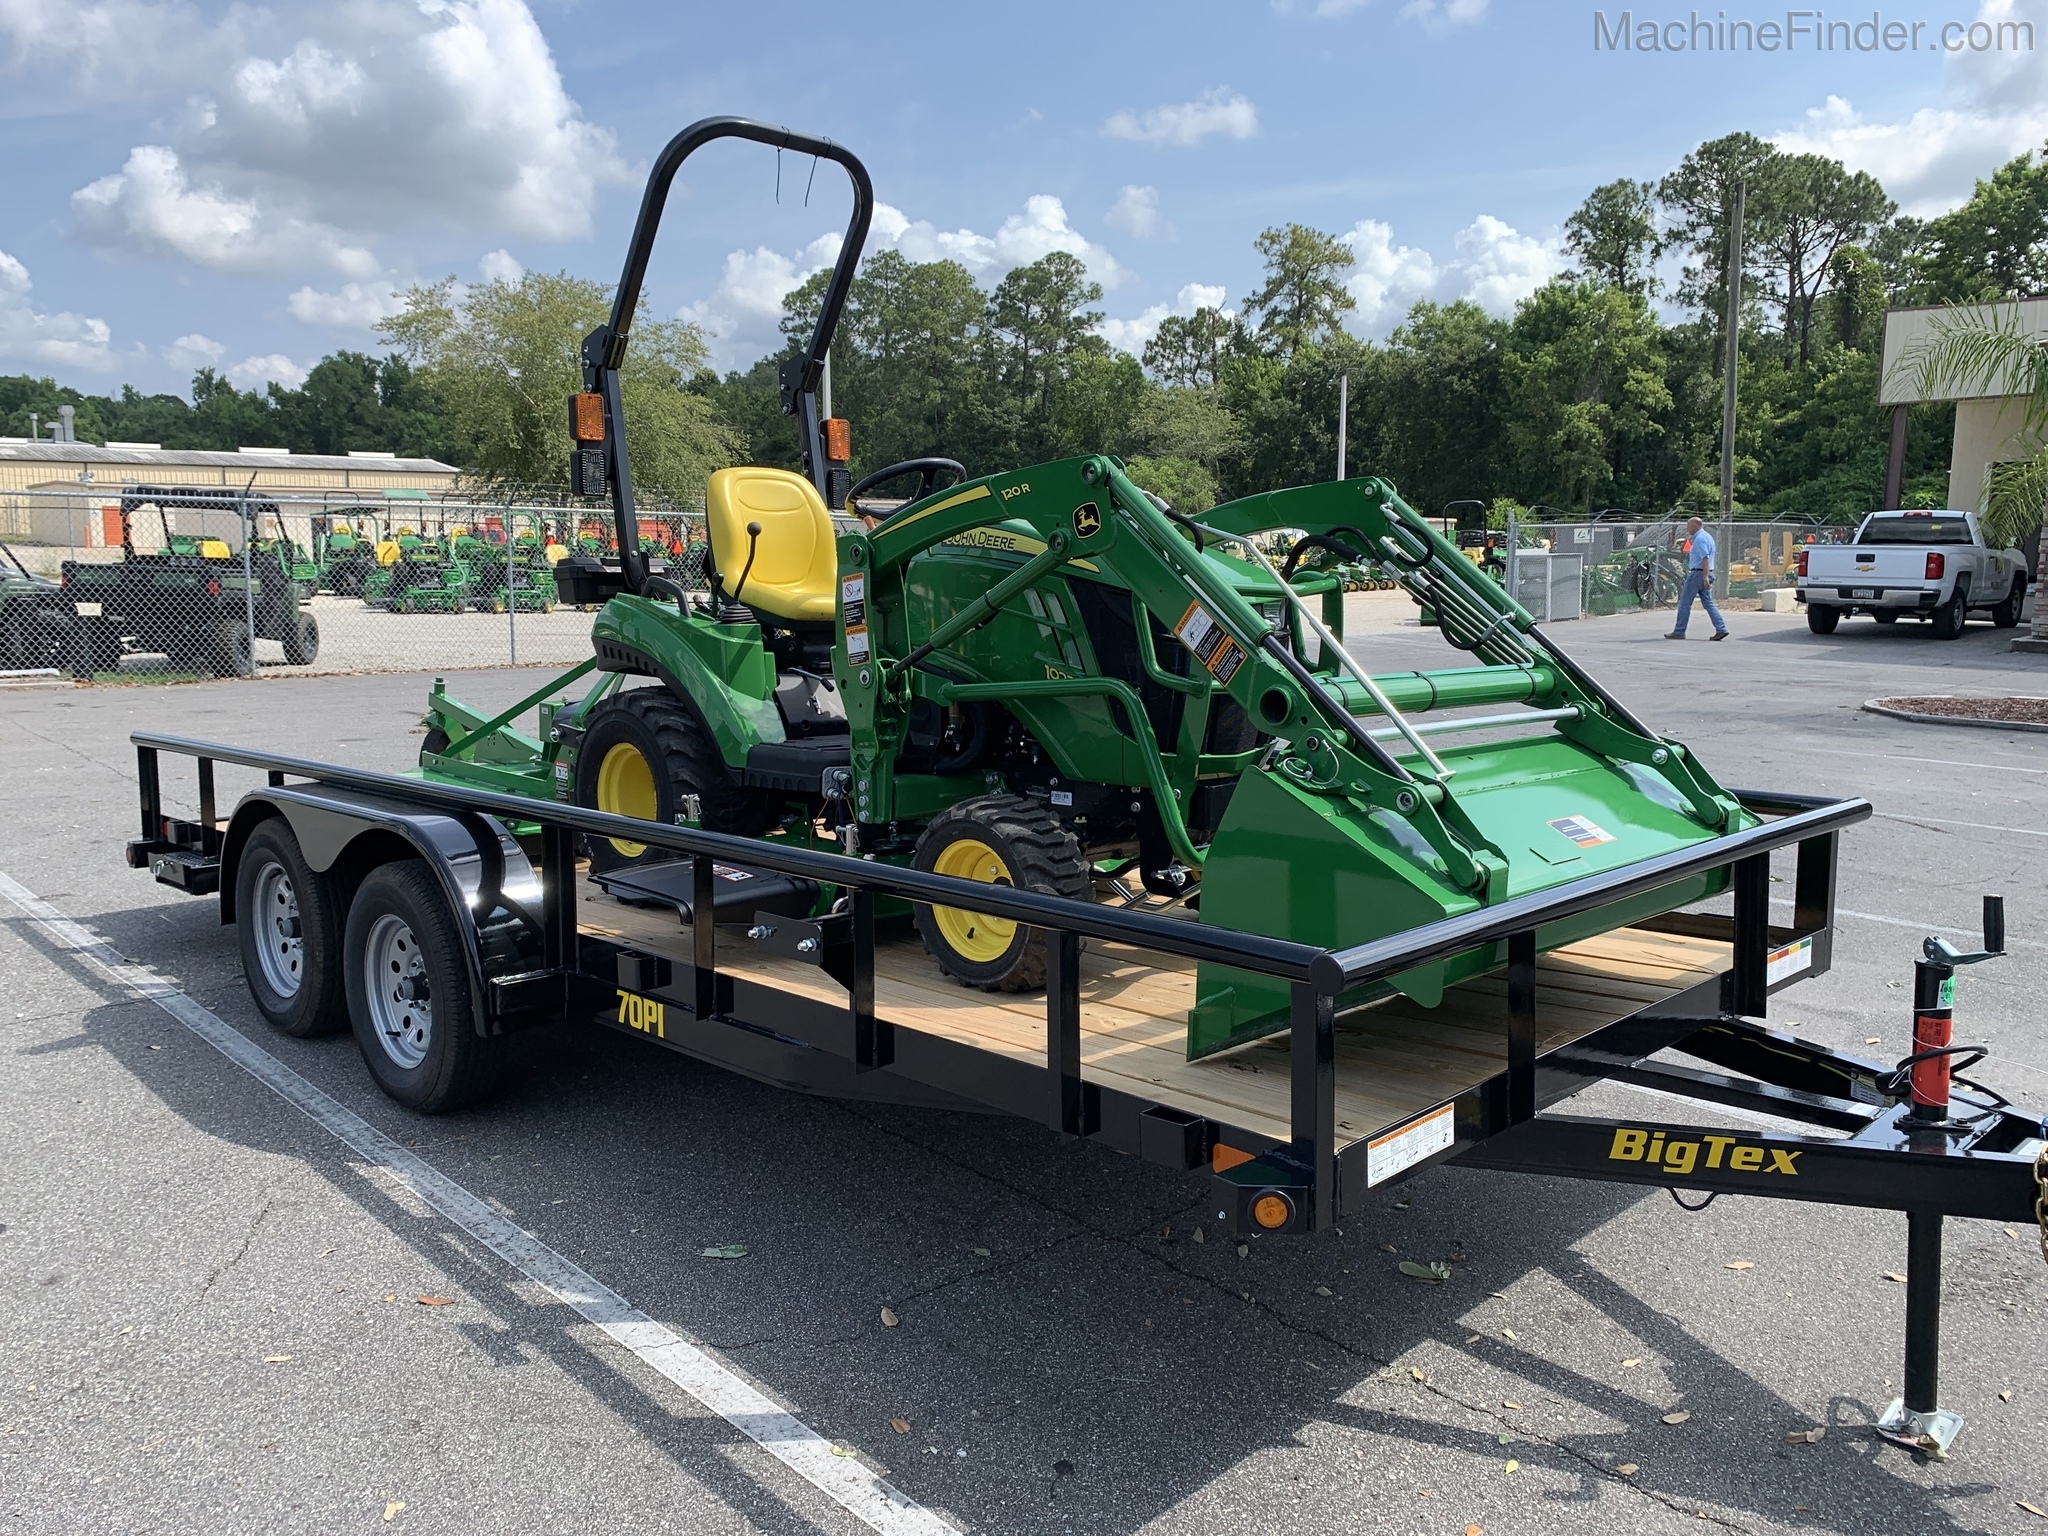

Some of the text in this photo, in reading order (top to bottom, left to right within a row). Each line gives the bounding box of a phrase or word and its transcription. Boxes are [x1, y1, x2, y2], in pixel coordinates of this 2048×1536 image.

[1000, 483, 1031, 501] 120 R
[977, 531, 1017, 549] DEERE
[616, 988, 665, 1039] 70PI
[1608, 1128, 1803, 1176] BigTex
